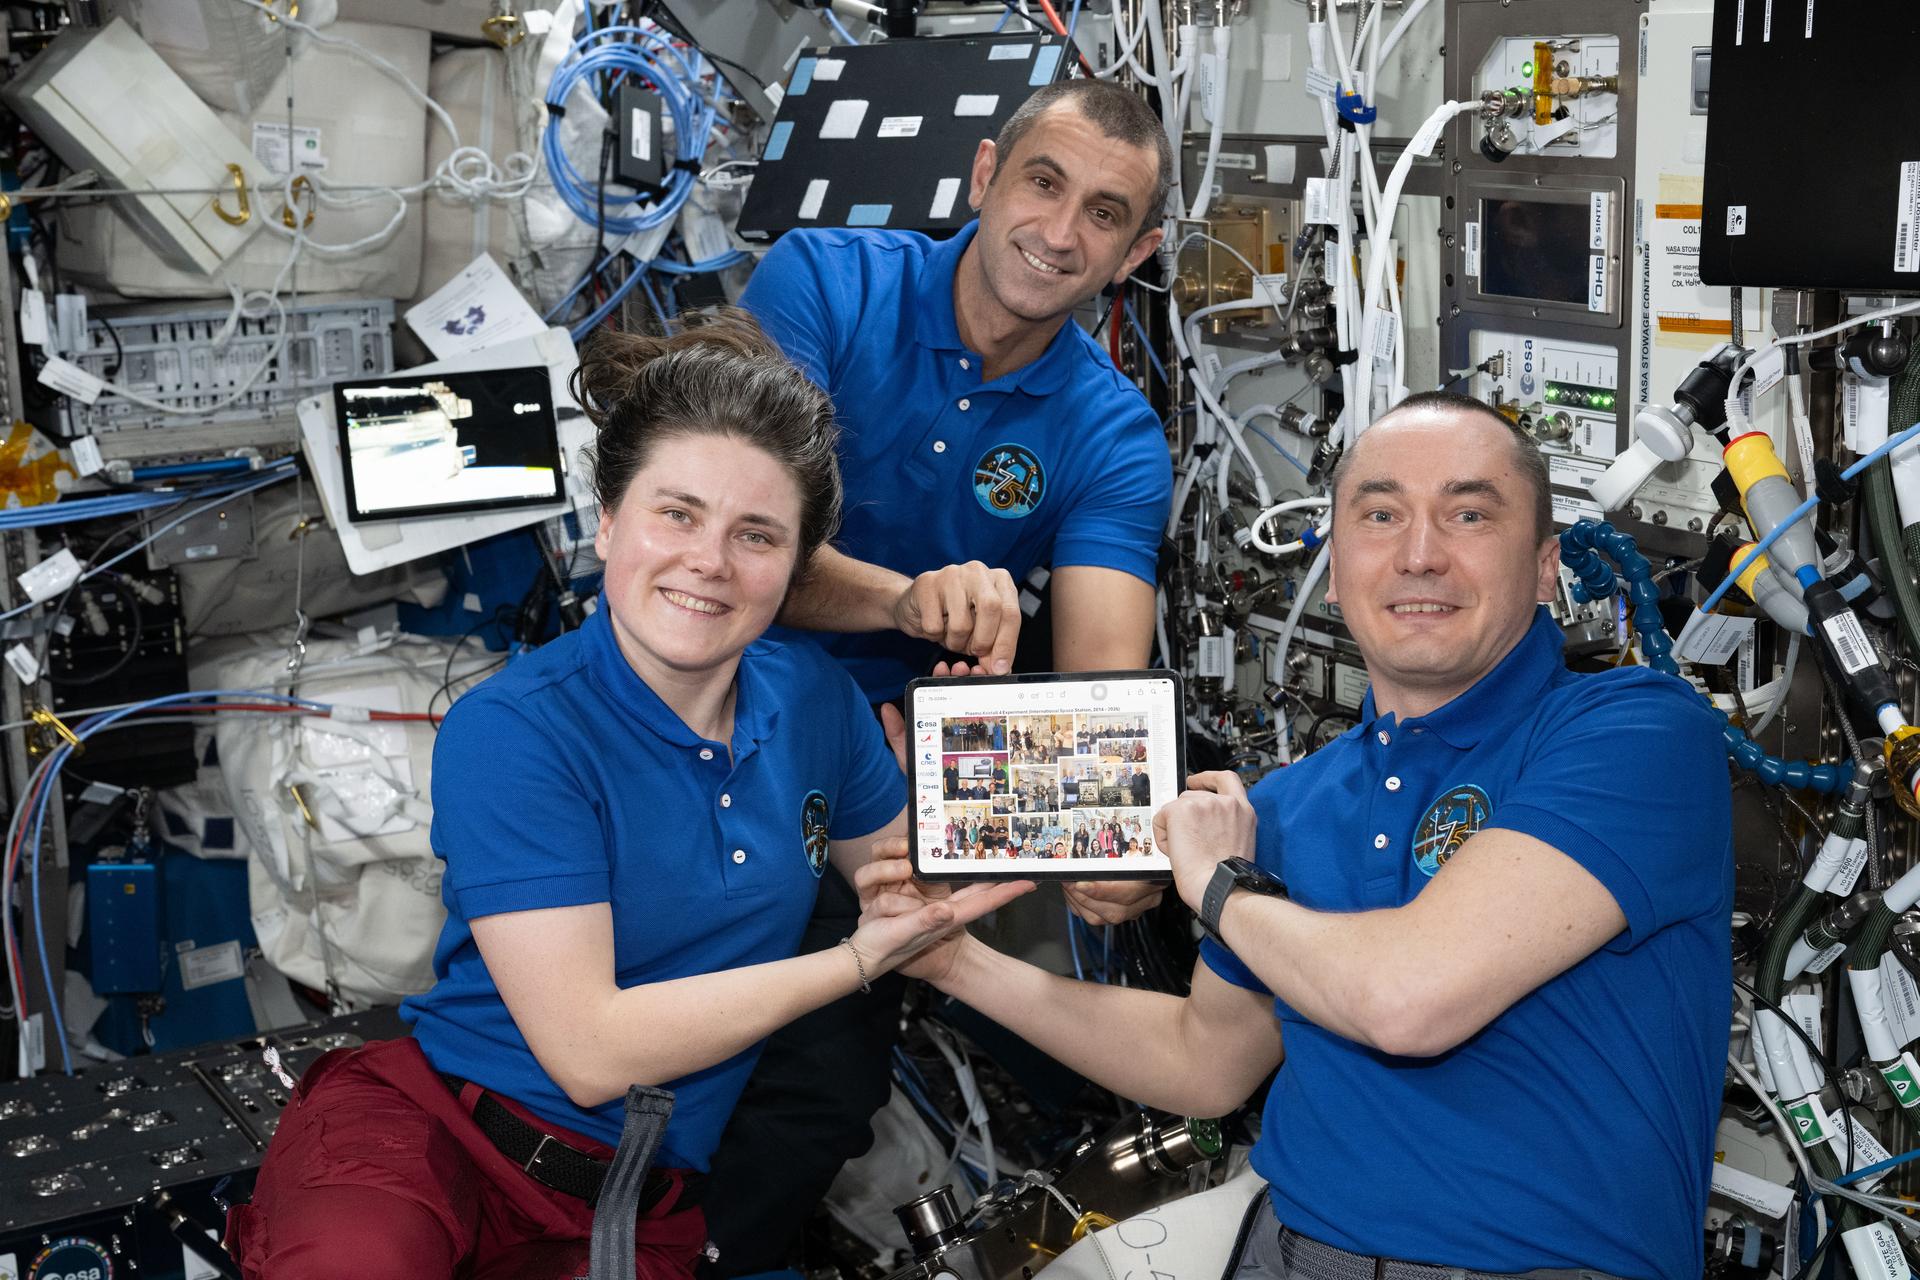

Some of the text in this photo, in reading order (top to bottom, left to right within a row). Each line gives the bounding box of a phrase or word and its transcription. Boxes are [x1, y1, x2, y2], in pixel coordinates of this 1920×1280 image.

[1850, 849, 1862, 867] Transfer
[1857, 1127, 1874, 1146] WATER
[1862, 1149, 1878, 1164] ATER
[1875, 1230, 1897, 1278] WASTE GAS
[1891, 1255, 1897, 1263] TO
[1894, 1247, 1904, 1266] WASTE
[66, 1267, 101, 1280] esa
